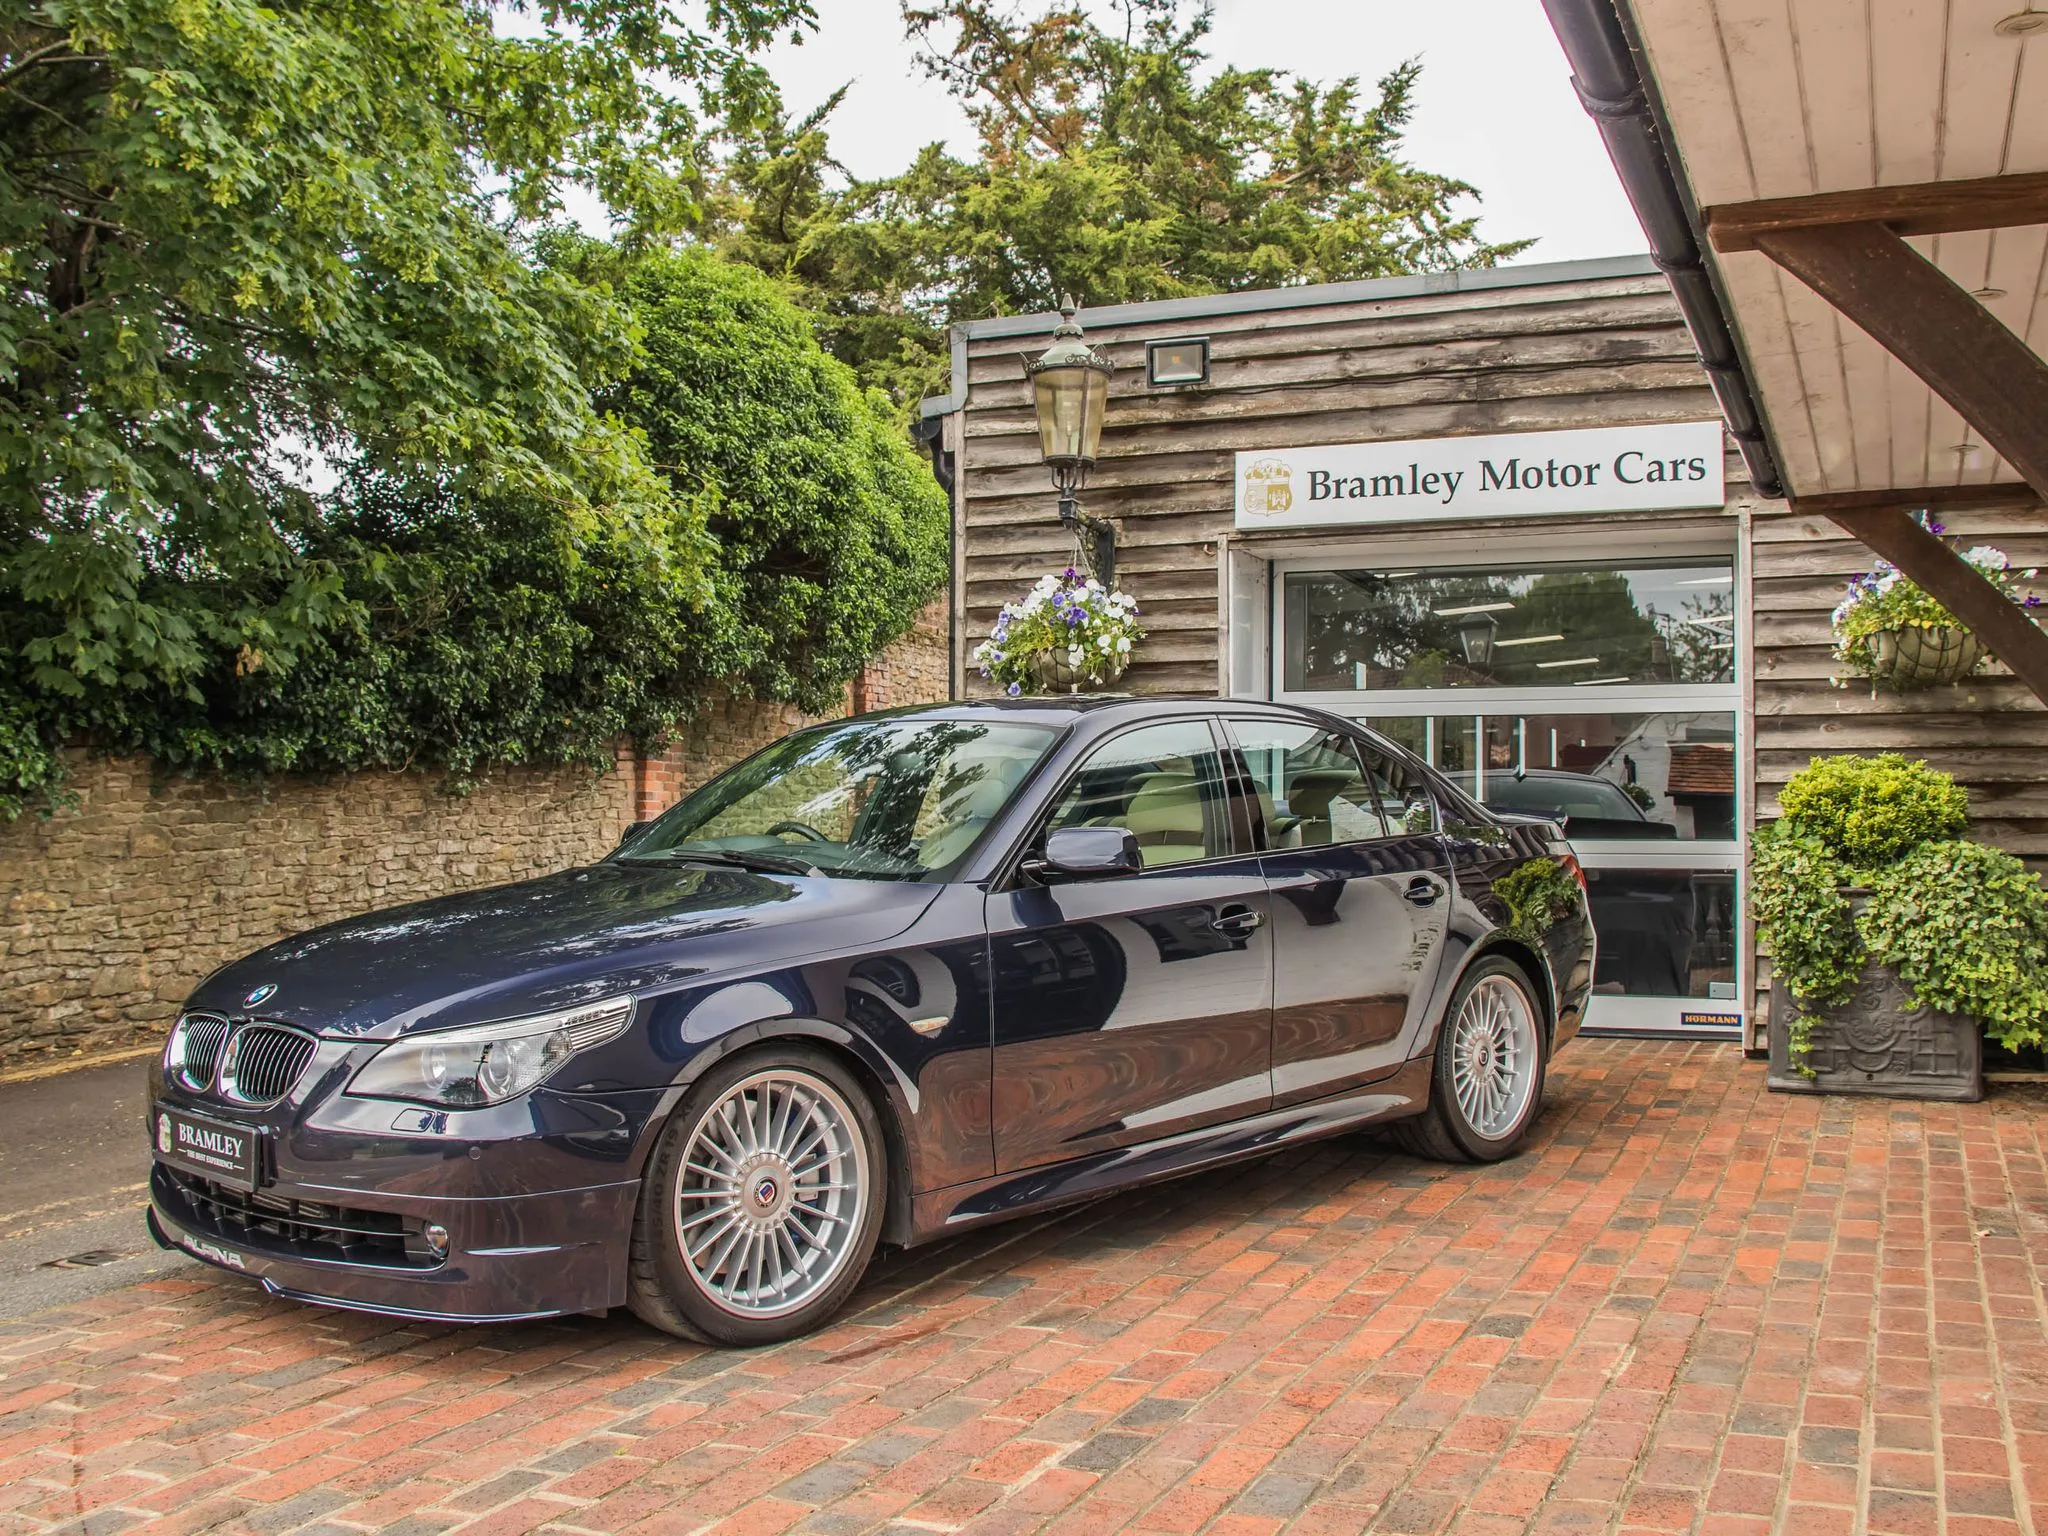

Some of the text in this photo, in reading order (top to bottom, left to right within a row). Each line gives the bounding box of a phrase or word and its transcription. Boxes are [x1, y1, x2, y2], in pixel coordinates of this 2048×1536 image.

[1307, 451, 1707, 504] Bramley Motor Cars
[178, 1122, 243, 1158] BRAMLEY
[186, 1149, 195, 1158] THE
[206, 1155, 234, 1170] EXPERIENCE
[184, 1234, 245, 1269] ALPINA
